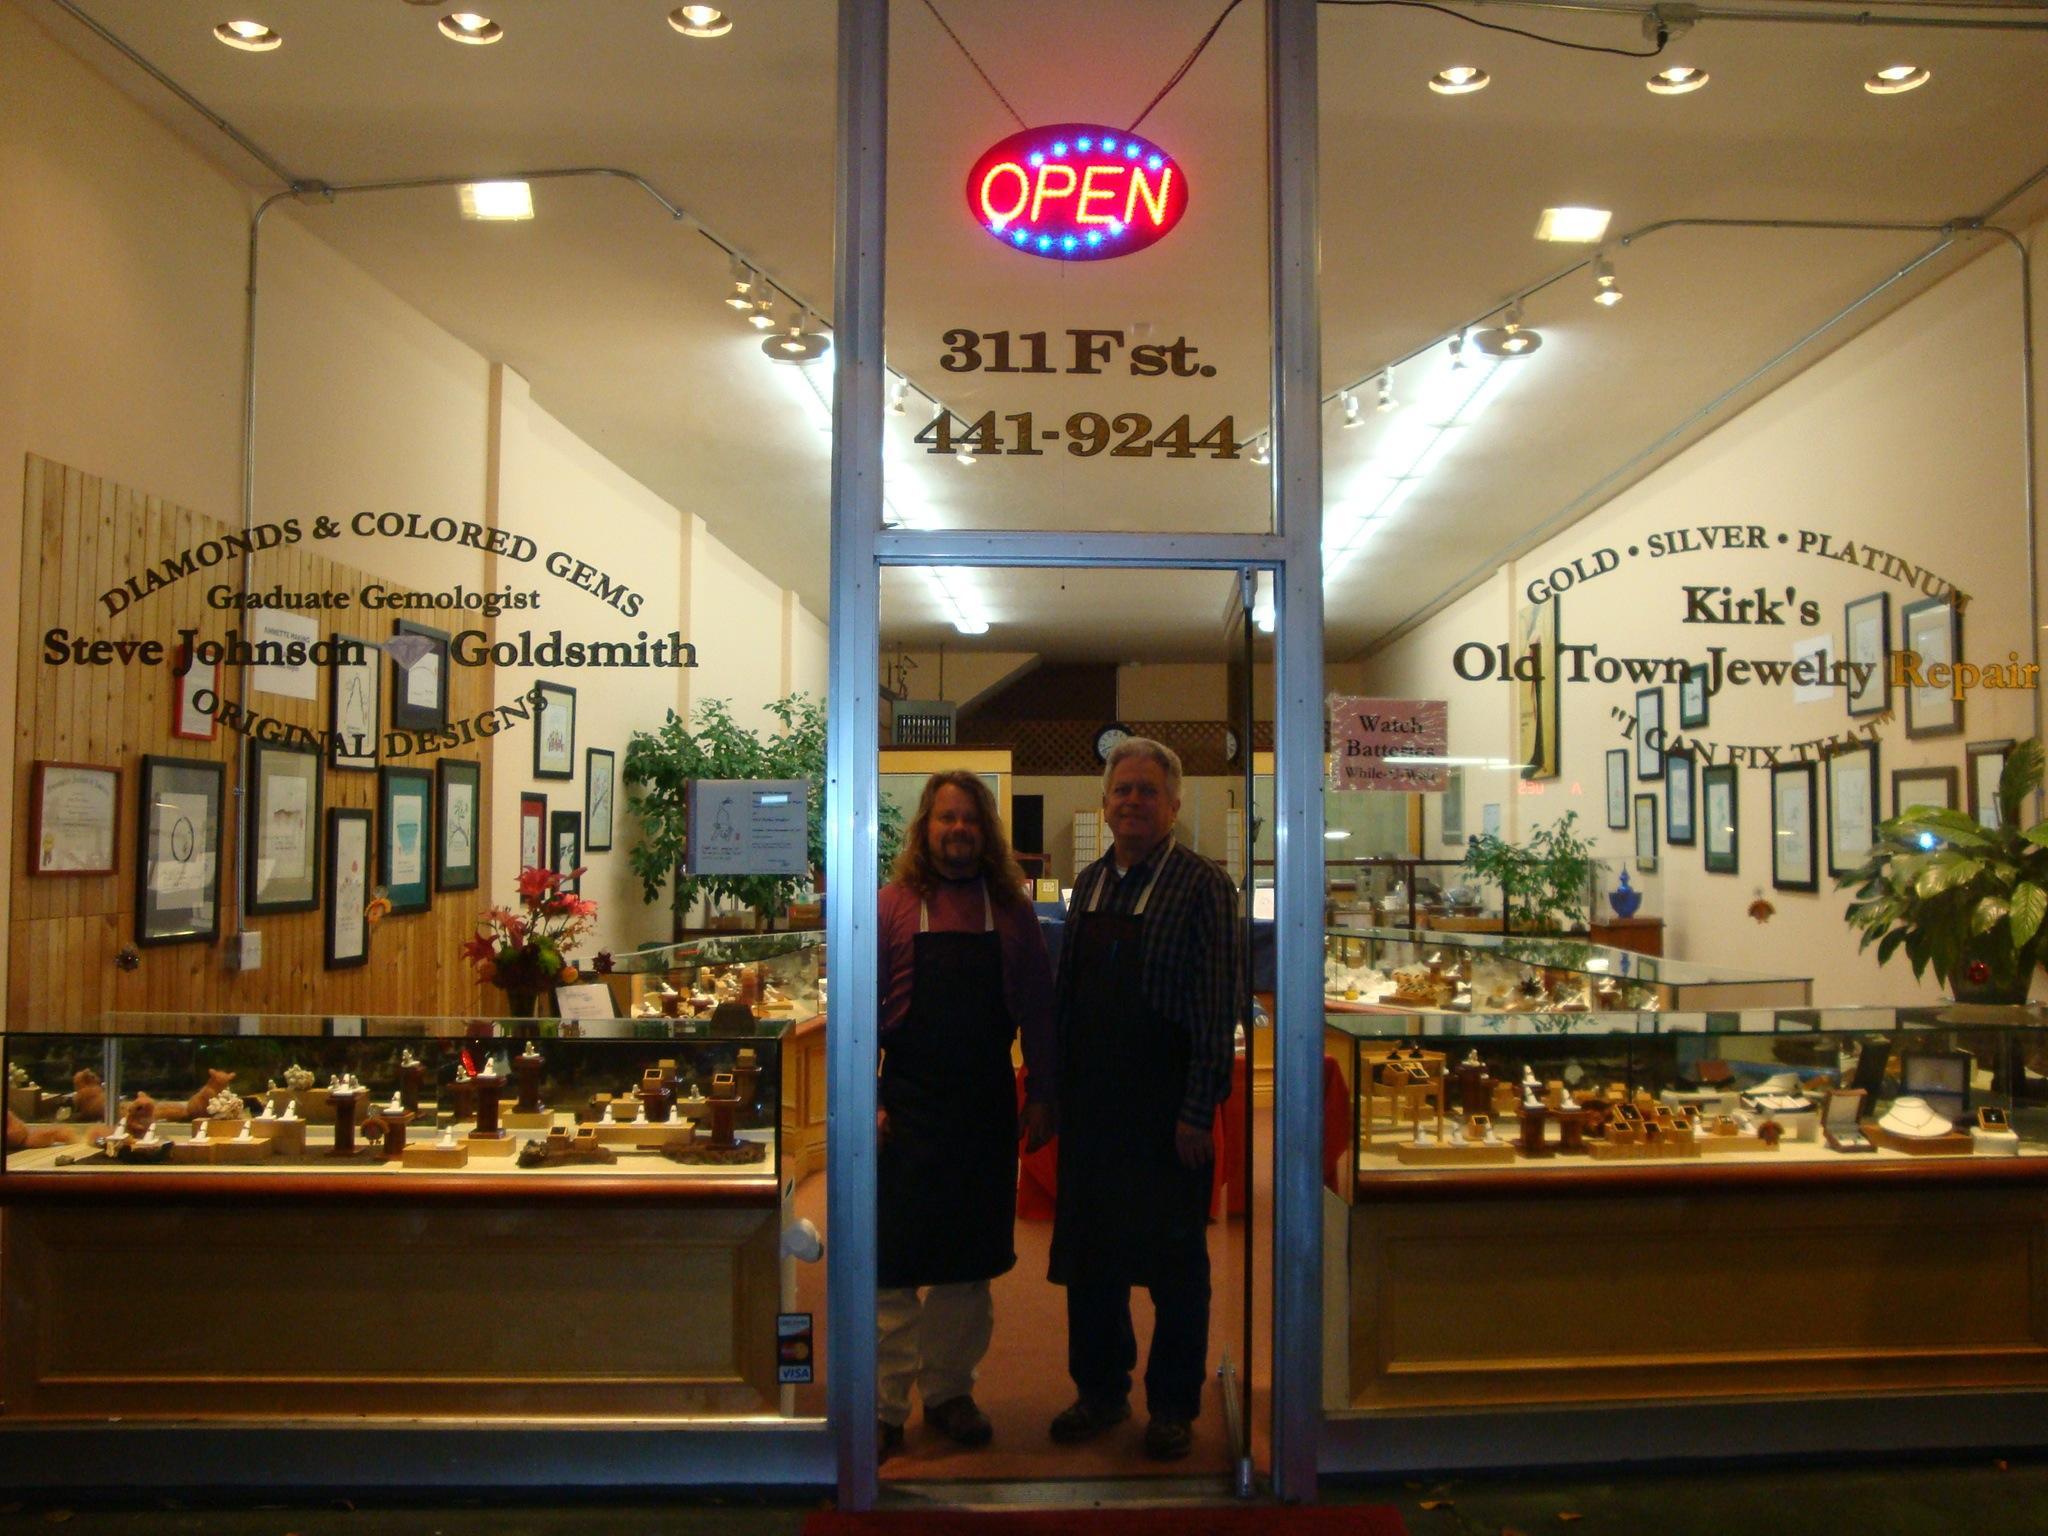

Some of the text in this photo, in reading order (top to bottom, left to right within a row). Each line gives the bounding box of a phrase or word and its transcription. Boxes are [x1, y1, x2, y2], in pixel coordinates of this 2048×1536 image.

[981, 161, 1172, 227] OPEN
[940, 329, 1217, 378] 311 F st.
[915, 411, 1243, 459] 441-9244
[98, 512, 645, 619] DIAMONDS & COLORED GEMS
[1526, 525, 1973, 612] GOLD SILVER PLATINUM
[207, 585, 540, 618] Graduate Gemologist
[1682, 586, 1820, 626] Kirk's
[44, 629, 699, 677] Steve Johnson Goldsmith
[1452, 643, 2040, 701] Old Town Jewelry Repair
[191, 687, 549, 759] ORIGINAL DESIGNS
[1359, 715, 1423, 733] Watch
[1644, 726, 1717, 767] CAN
[1730, 745, 1790, 770] FIX
[783, 1367, 809, 1378] VISA
